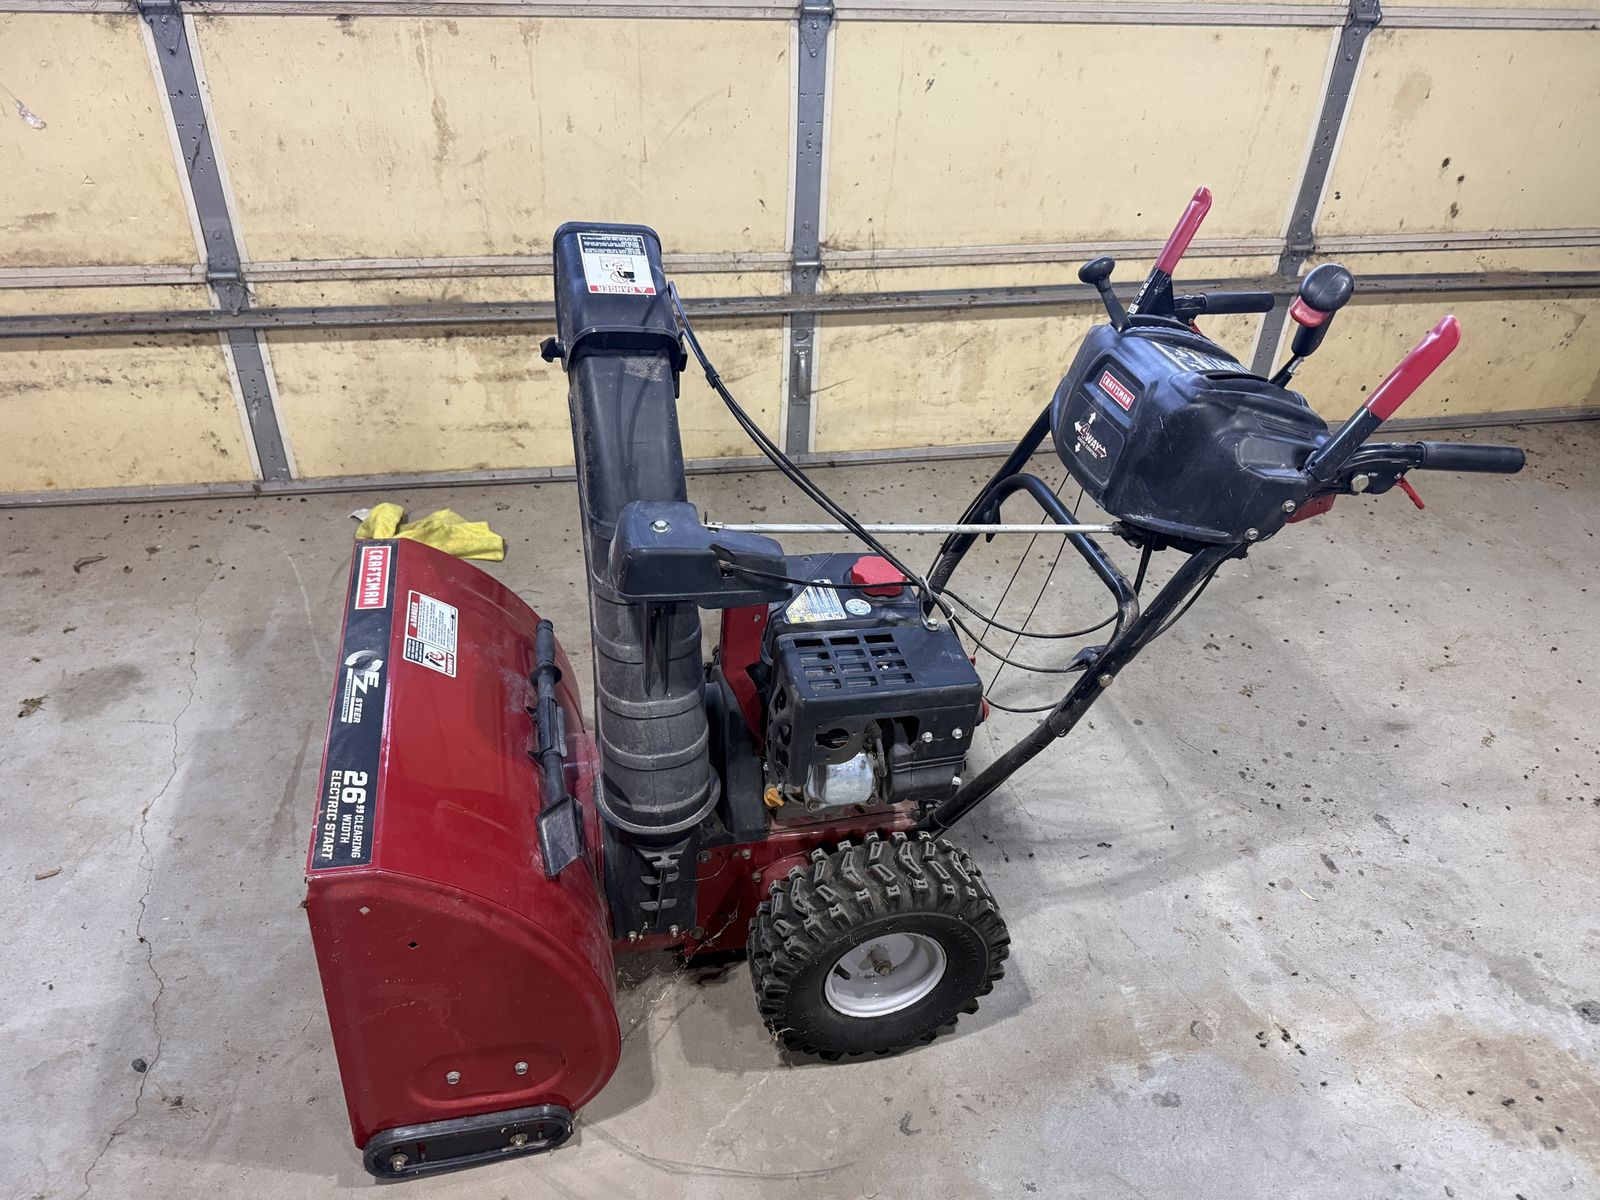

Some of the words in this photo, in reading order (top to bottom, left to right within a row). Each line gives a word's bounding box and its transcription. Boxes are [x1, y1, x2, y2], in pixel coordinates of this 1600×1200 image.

[1102, 376, 1132, 405] CRAFTSMAN
[363, 549, 384, 605] CRAFTSMAN
[410, 602, 419, 624] DANGER
[352, 697, 363, 724] STEER
[326, 770, 342, 821] ELECTRIC
[321, 822, 336, 860] START
[340, 814, 352, 844] WIDTH
[351, 814, 364, 859] CLEARING
